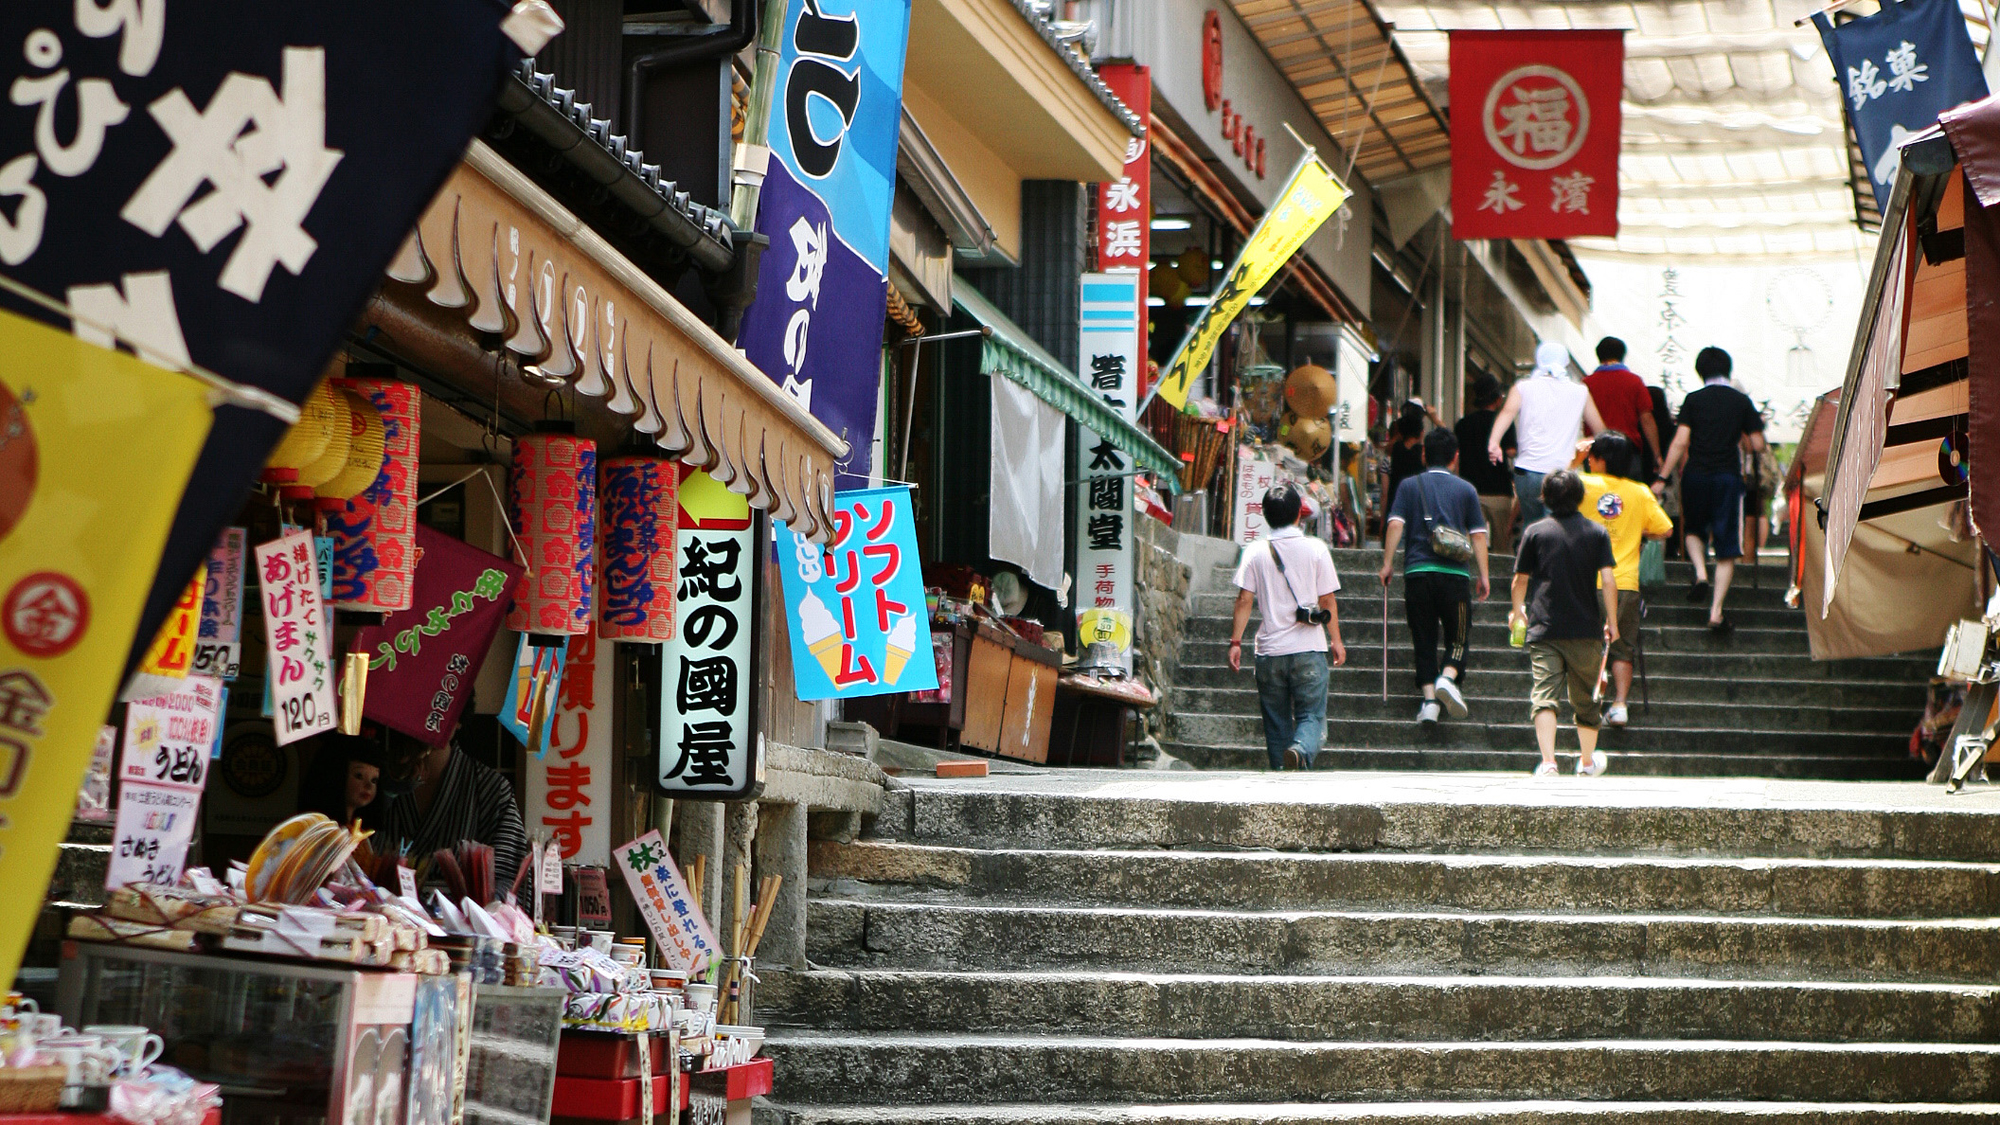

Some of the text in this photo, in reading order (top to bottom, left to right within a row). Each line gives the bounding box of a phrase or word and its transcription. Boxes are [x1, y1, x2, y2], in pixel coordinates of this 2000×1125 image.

[1848, 41, 1929, 111] 銘菓
[1500, 86, 1573, 155] 福
[1105, 177, 1142, 274] 永浜
[1088, 353, 1127, 551] 箸太閤堂
[1244, 502, 1262, 547] 貸しま
[853, 499, 908, 632] ソフト
[263, 552, 305, 686] あげまん
[662, 536, 743, 786] 紀の國屋
[281, 692, 331, 735] 120円
[155, 745, 204, 785] うどん
[627, 842, 660, 873] 杖
[652, 840, 667, 860] つえ
